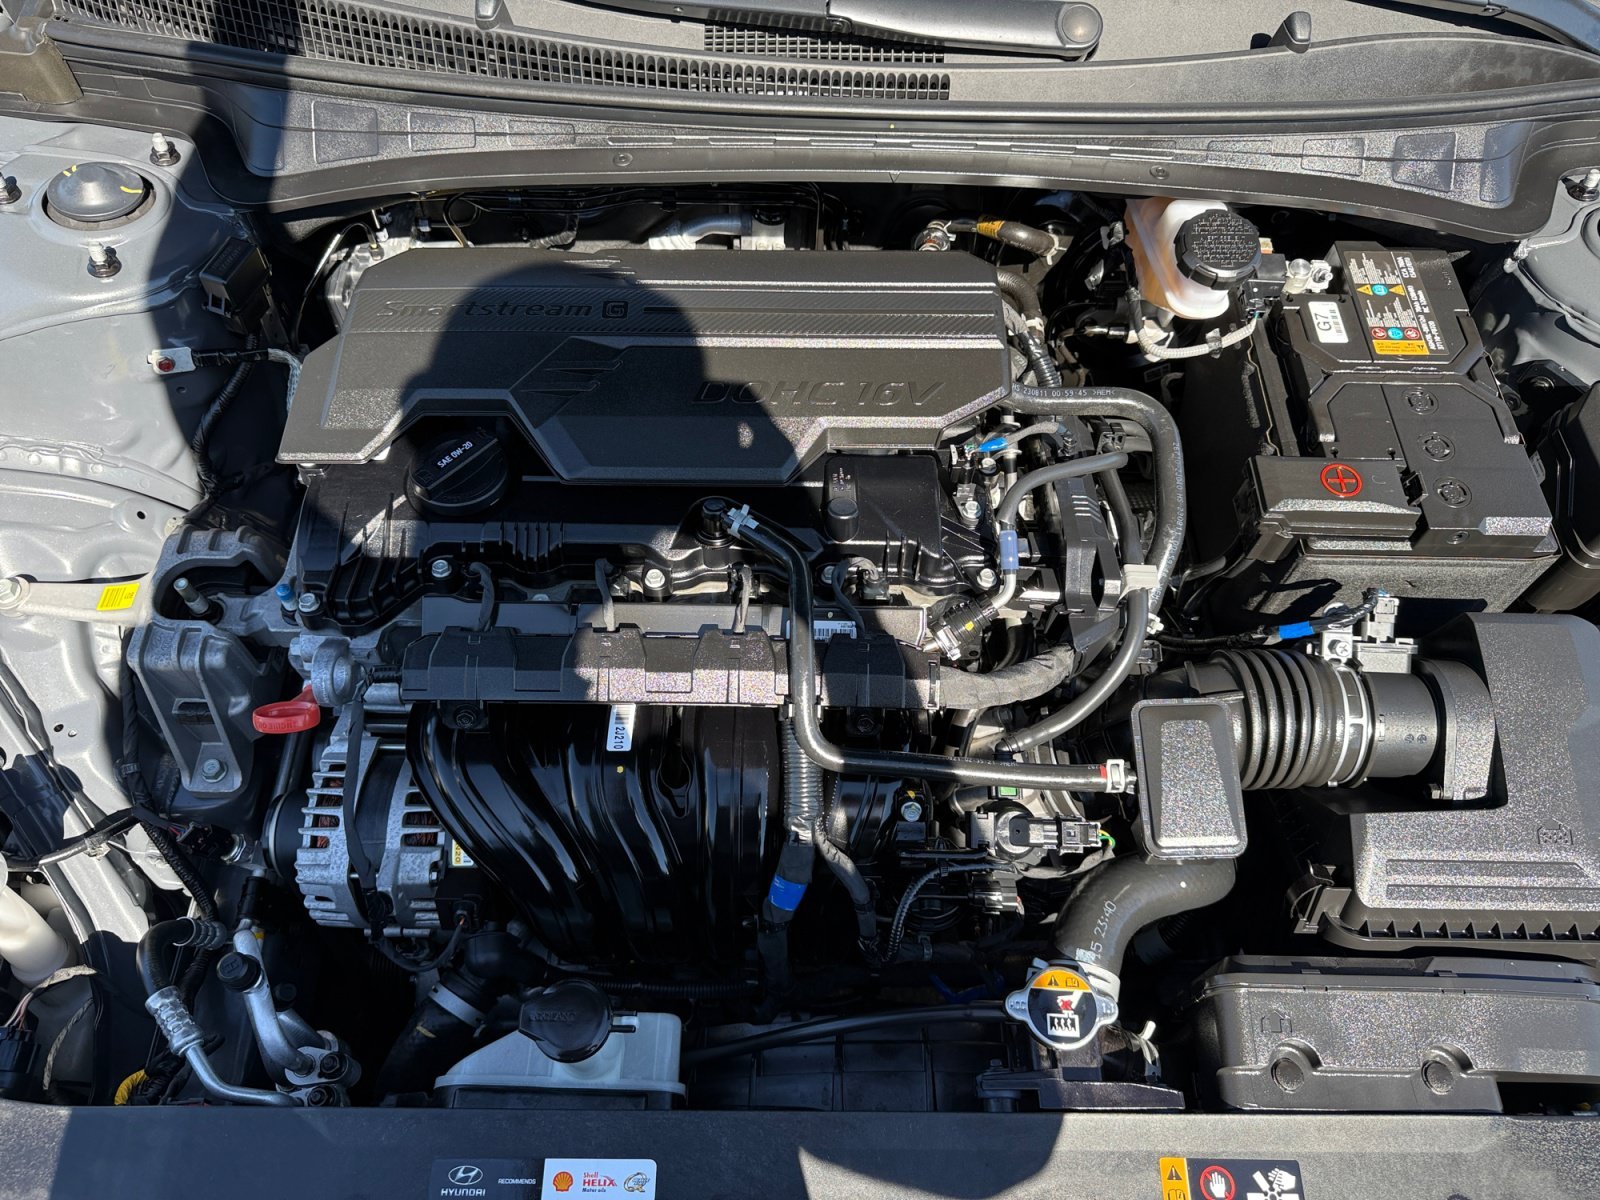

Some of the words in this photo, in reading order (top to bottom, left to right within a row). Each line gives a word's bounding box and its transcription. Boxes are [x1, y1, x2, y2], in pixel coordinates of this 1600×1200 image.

[377, 300, 592, 317] Smartstream
[1313, 312, 1332, 332] G7
[691, 380, 846, 406] DOHC
[856, 381, 946, 406] 16V
[1023, 386, 1047, 397] 230811
[436, 455, 454, 468] SAE
[450, 440, 474, 458] 0W-20
[613, 726, 626, 750] 2J210
[1093, 900, 1117, 939] 23:40
[582, 1178, 617, 1186] HELIX
[440, 1188, 486, 1198] HYUNDAI
